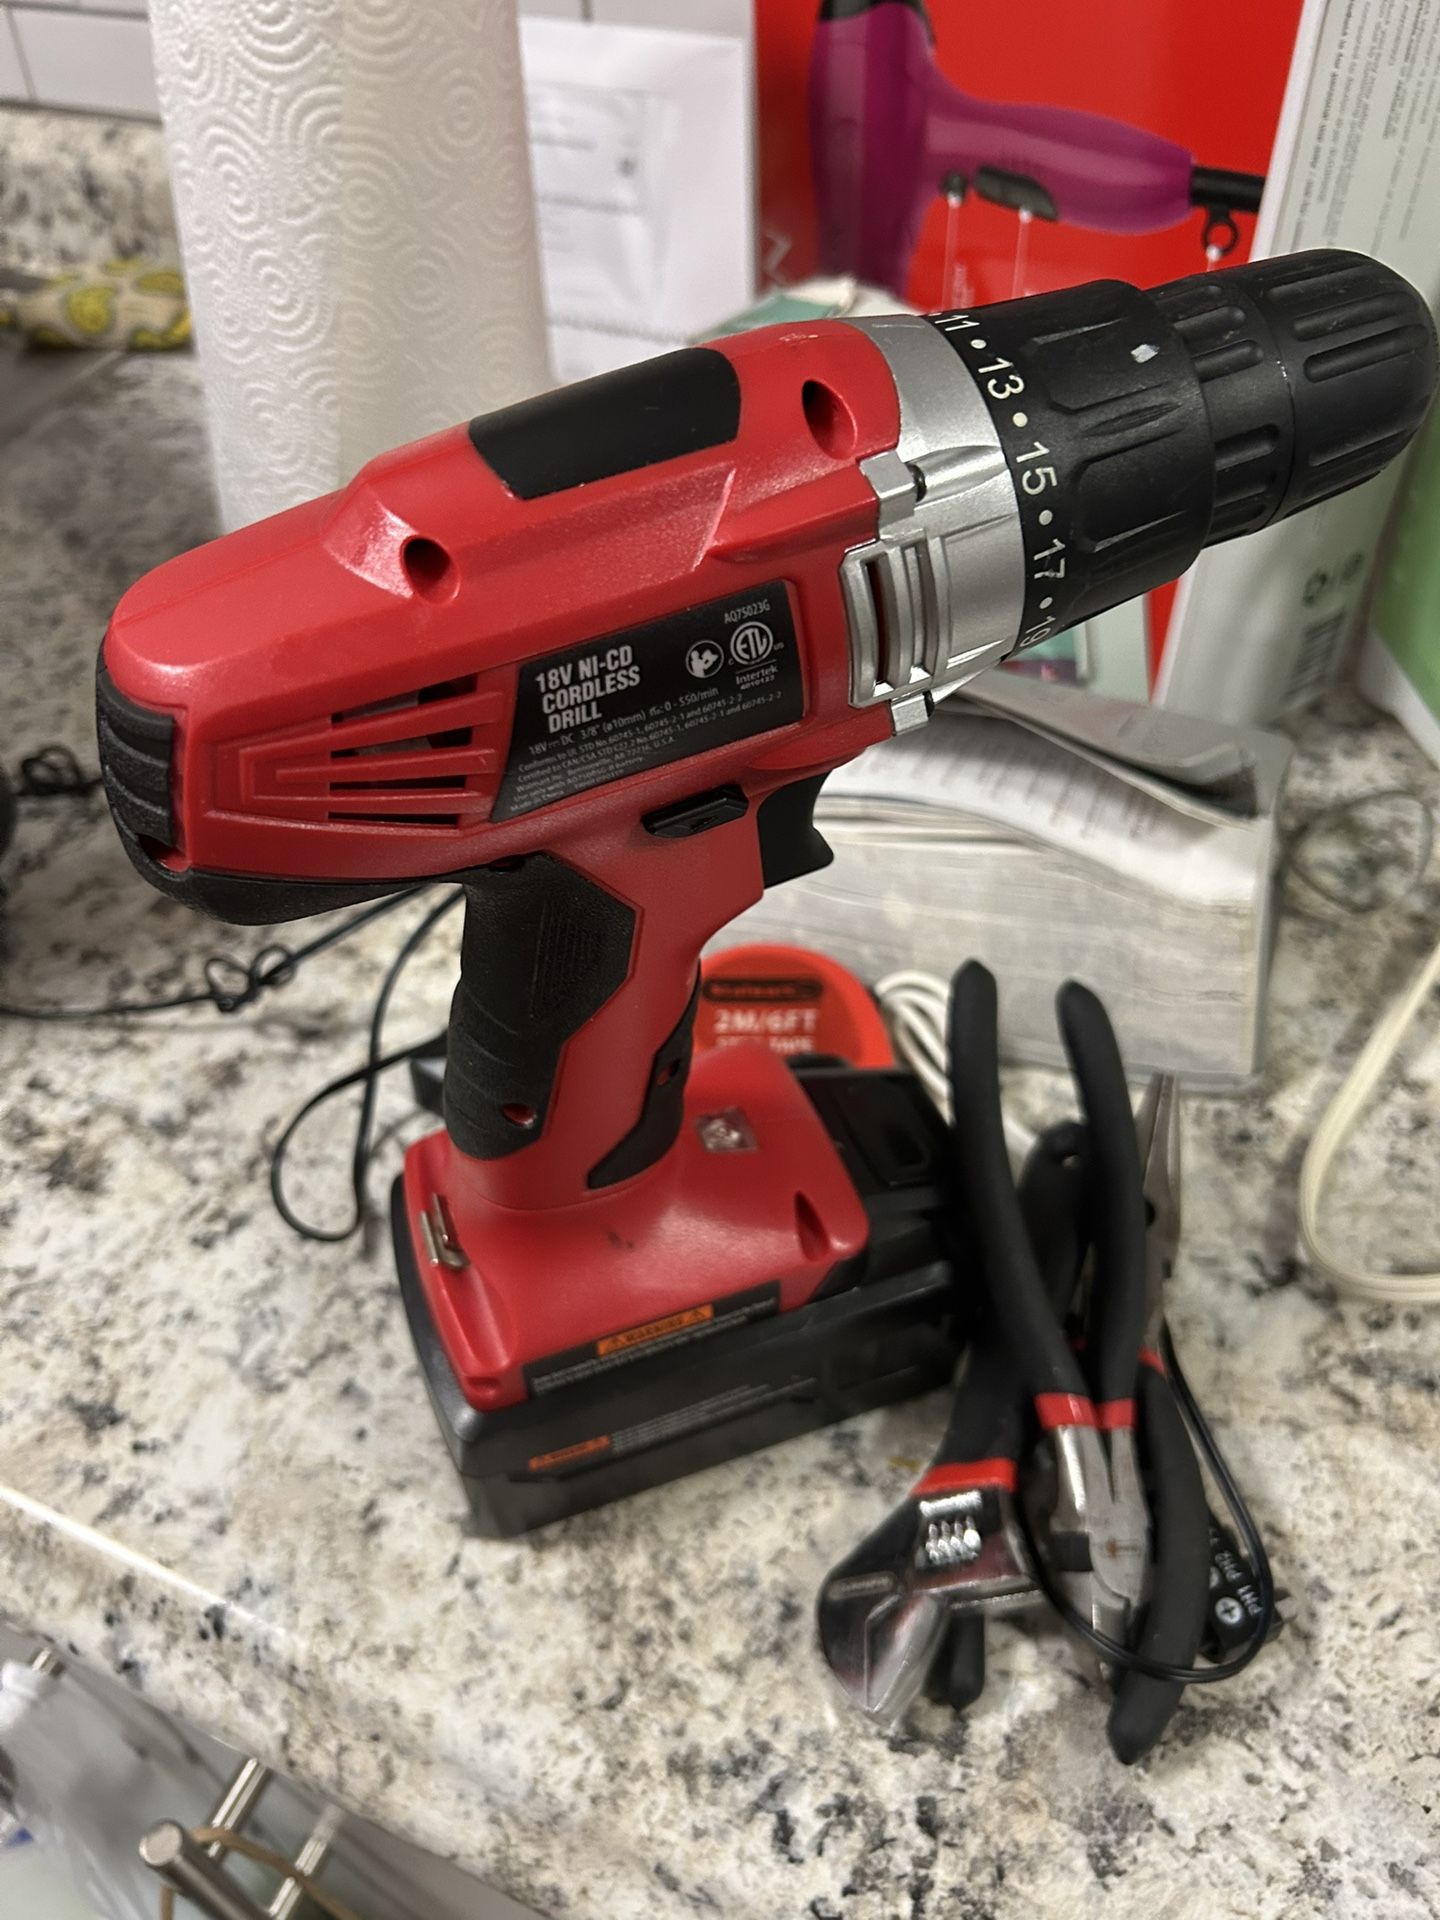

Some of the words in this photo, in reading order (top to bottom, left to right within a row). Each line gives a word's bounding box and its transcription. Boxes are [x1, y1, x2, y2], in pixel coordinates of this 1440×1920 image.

[978, 357, 1025, 399] 13
[1016, 441, 1058, 495] 15
[1033, 538, 1066, 579] 17
[1019, 615, 1057, 647] 19
[536, 663, 573, 693] 18V
[578, 645, 633, 680] NI-CD
[542, 665, 641, 714] CORDLESS
[736, 665, 778, 684] Intertek
[548, 701, 602, 734] DRILL
